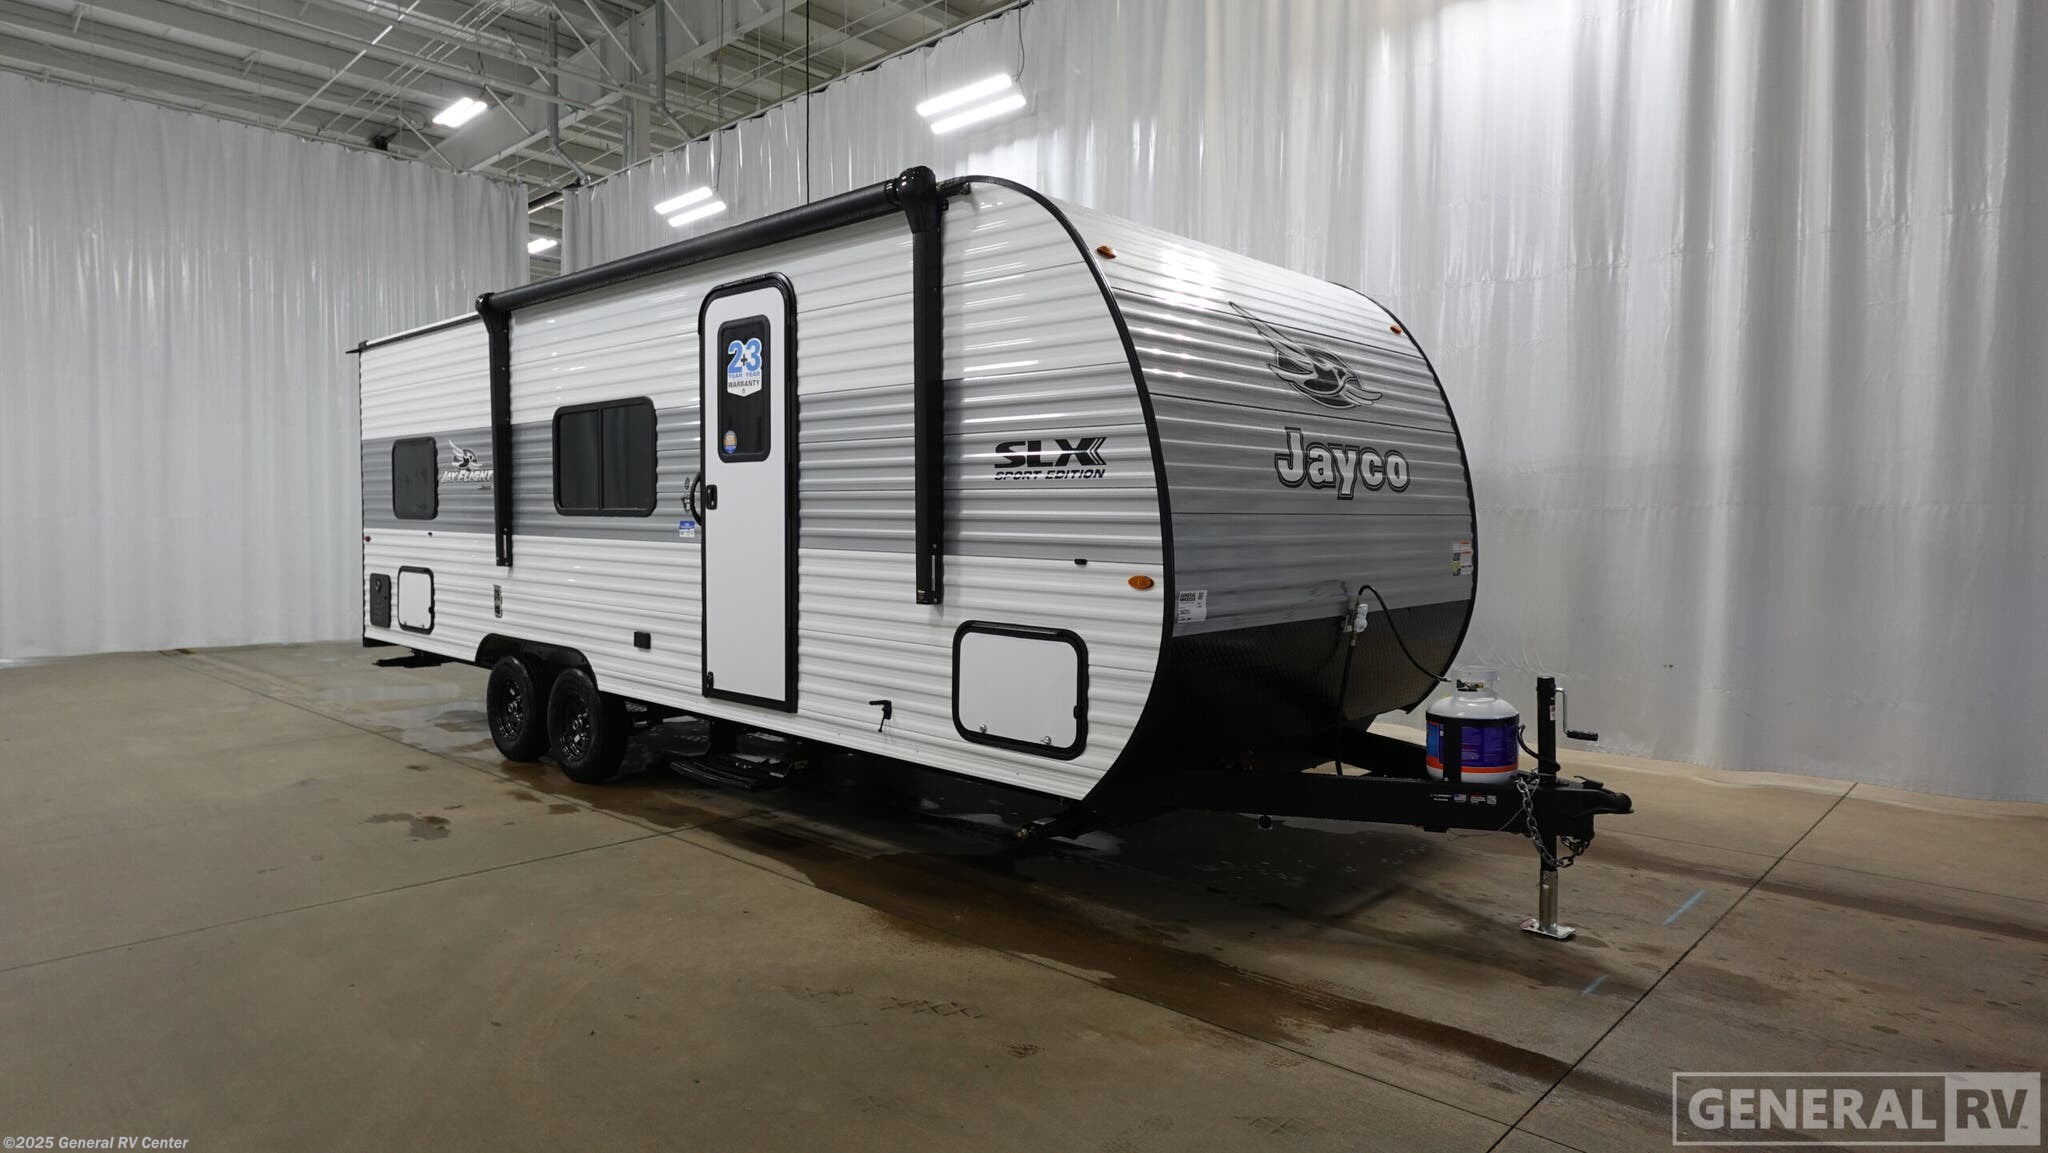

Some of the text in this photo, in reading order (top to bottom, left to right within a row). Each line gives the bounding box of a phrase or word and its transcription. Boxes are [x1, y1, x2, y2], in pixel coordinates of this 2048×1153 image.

[728, 380, 760, 388] WARRANTY
[994, 437, 1107, 468] SLX
[1274, 426, 1411, 500] Jayco
[441, 470, 494, 483] JAY FLIGHT
[994, 469, 1106, 480] SPORT EDITION
